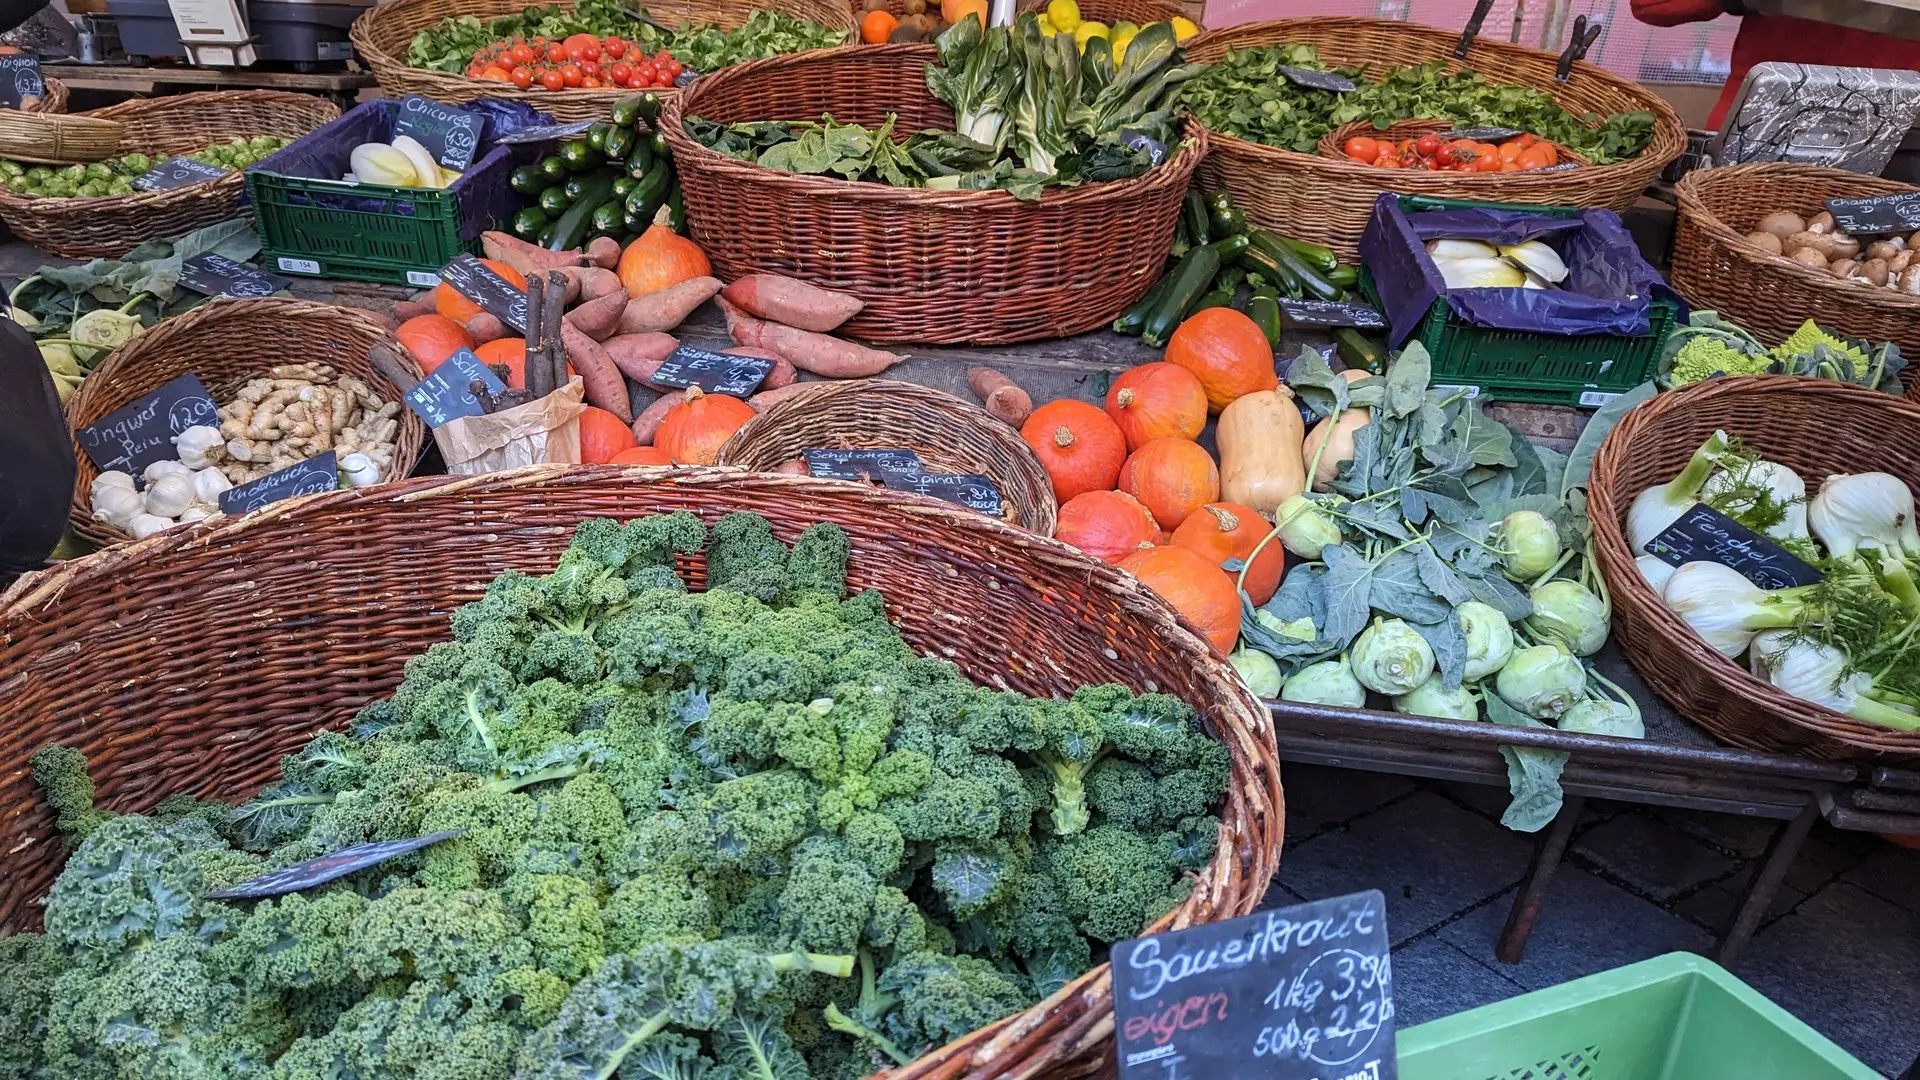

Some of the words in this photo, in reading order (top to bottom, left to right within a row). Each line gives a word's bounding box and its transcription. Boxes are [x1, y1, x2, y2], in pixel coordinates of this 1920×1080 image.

[406, 97, 471, 128] Chicorée
[902, 474, 964, 486] Spinat
[1689, 513, 1777, 562] Fenchel
[1130, 900, 1376, 1001] Sauerkraut
[1123, 992, 1229, 1045] eigen
